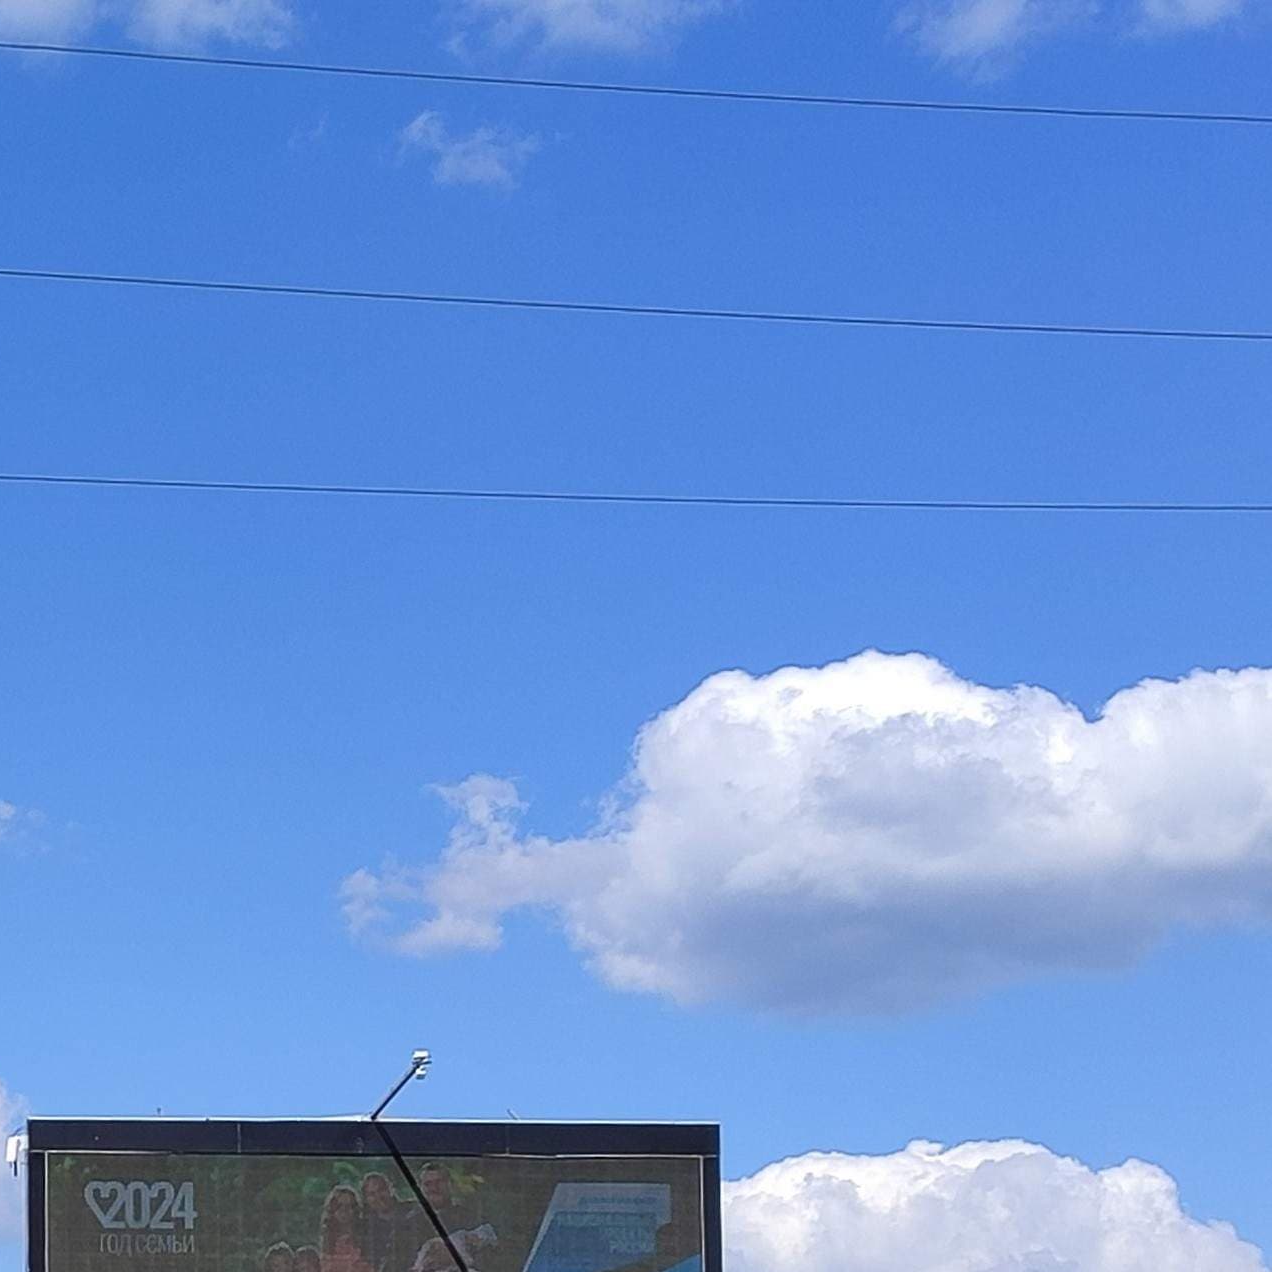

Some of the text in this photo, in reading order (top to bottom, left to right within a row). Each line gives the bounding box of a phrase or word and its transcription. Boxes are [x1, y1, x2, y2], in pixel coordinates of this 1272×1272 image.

[97, 1181, 197, 1229] 2024
[100, 1233, 195, 1257] ГОД СЕМЬИ
